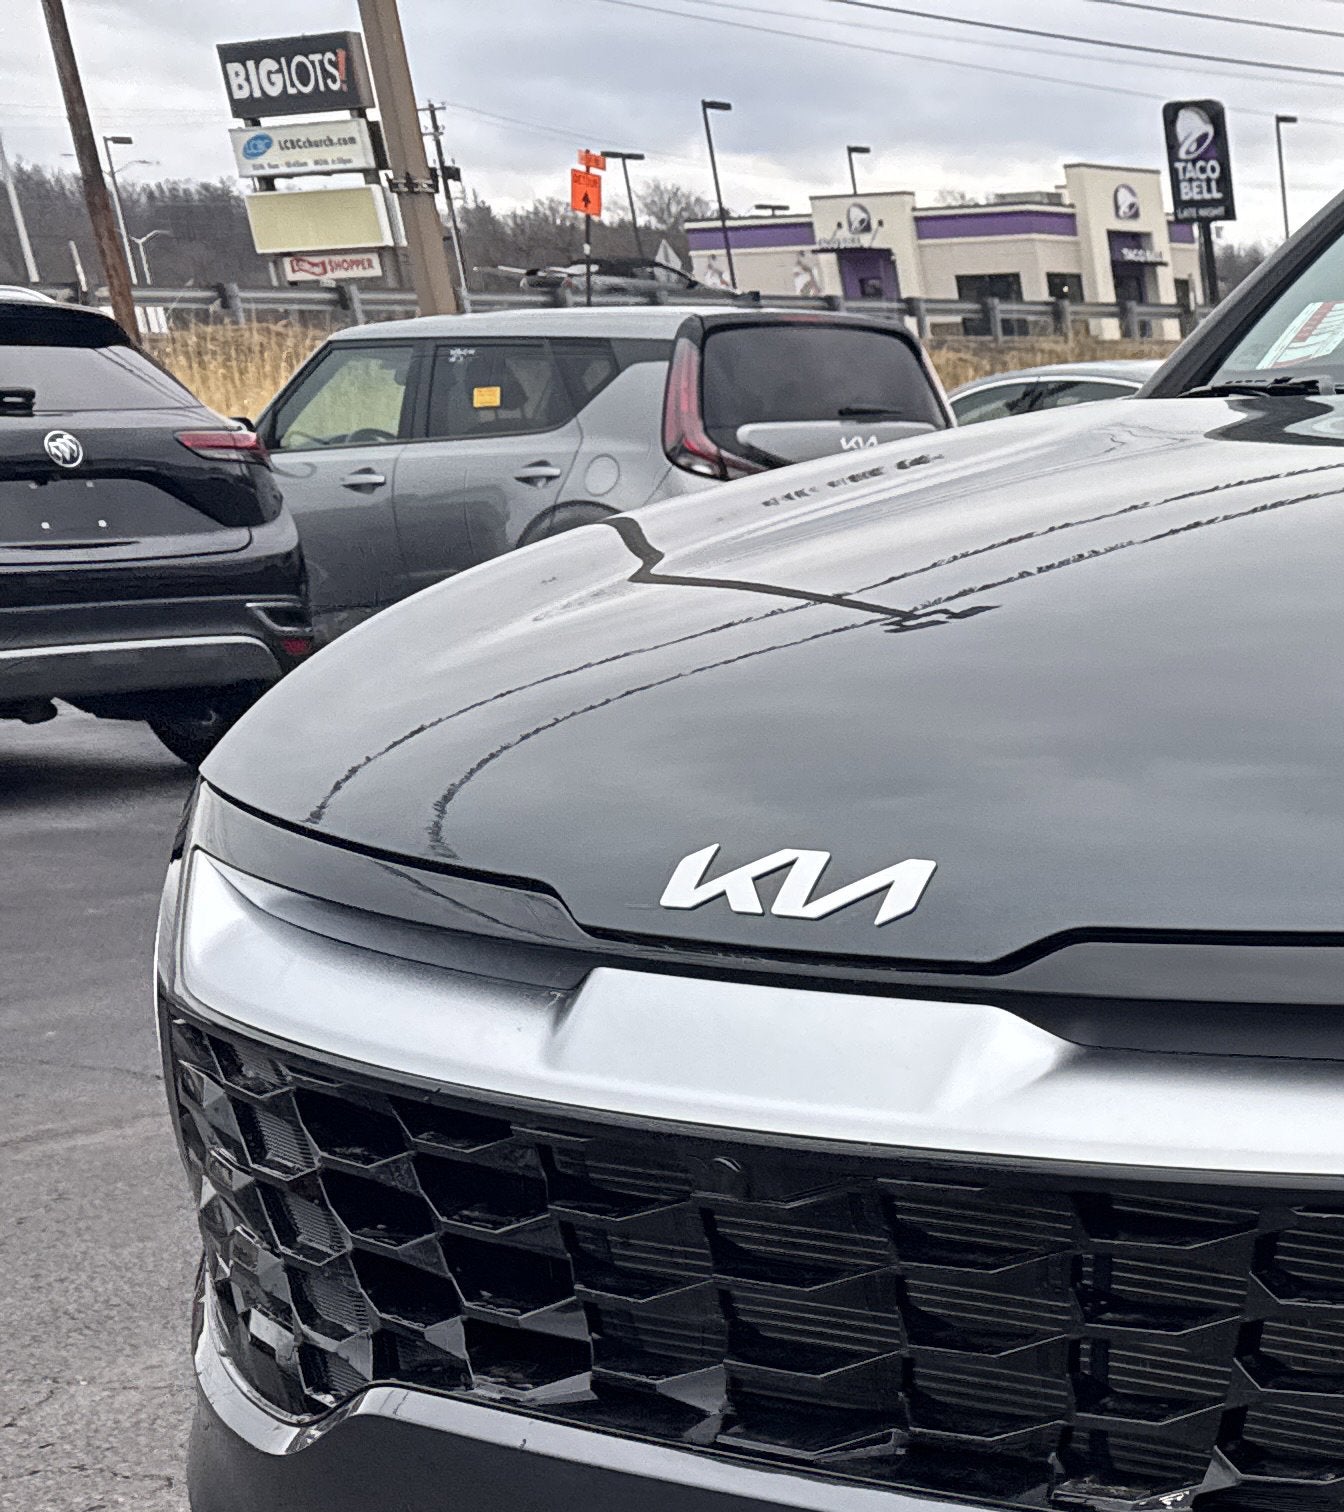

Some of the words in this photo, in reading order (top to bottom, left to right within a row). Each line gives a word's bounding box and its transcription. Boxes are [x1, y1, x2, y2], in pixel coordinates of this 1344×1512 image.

[1174, 160, 1220, 180] TACO
[1180, 180, 1223, 200] BELL
[659, 842, 938, 928] KIA
